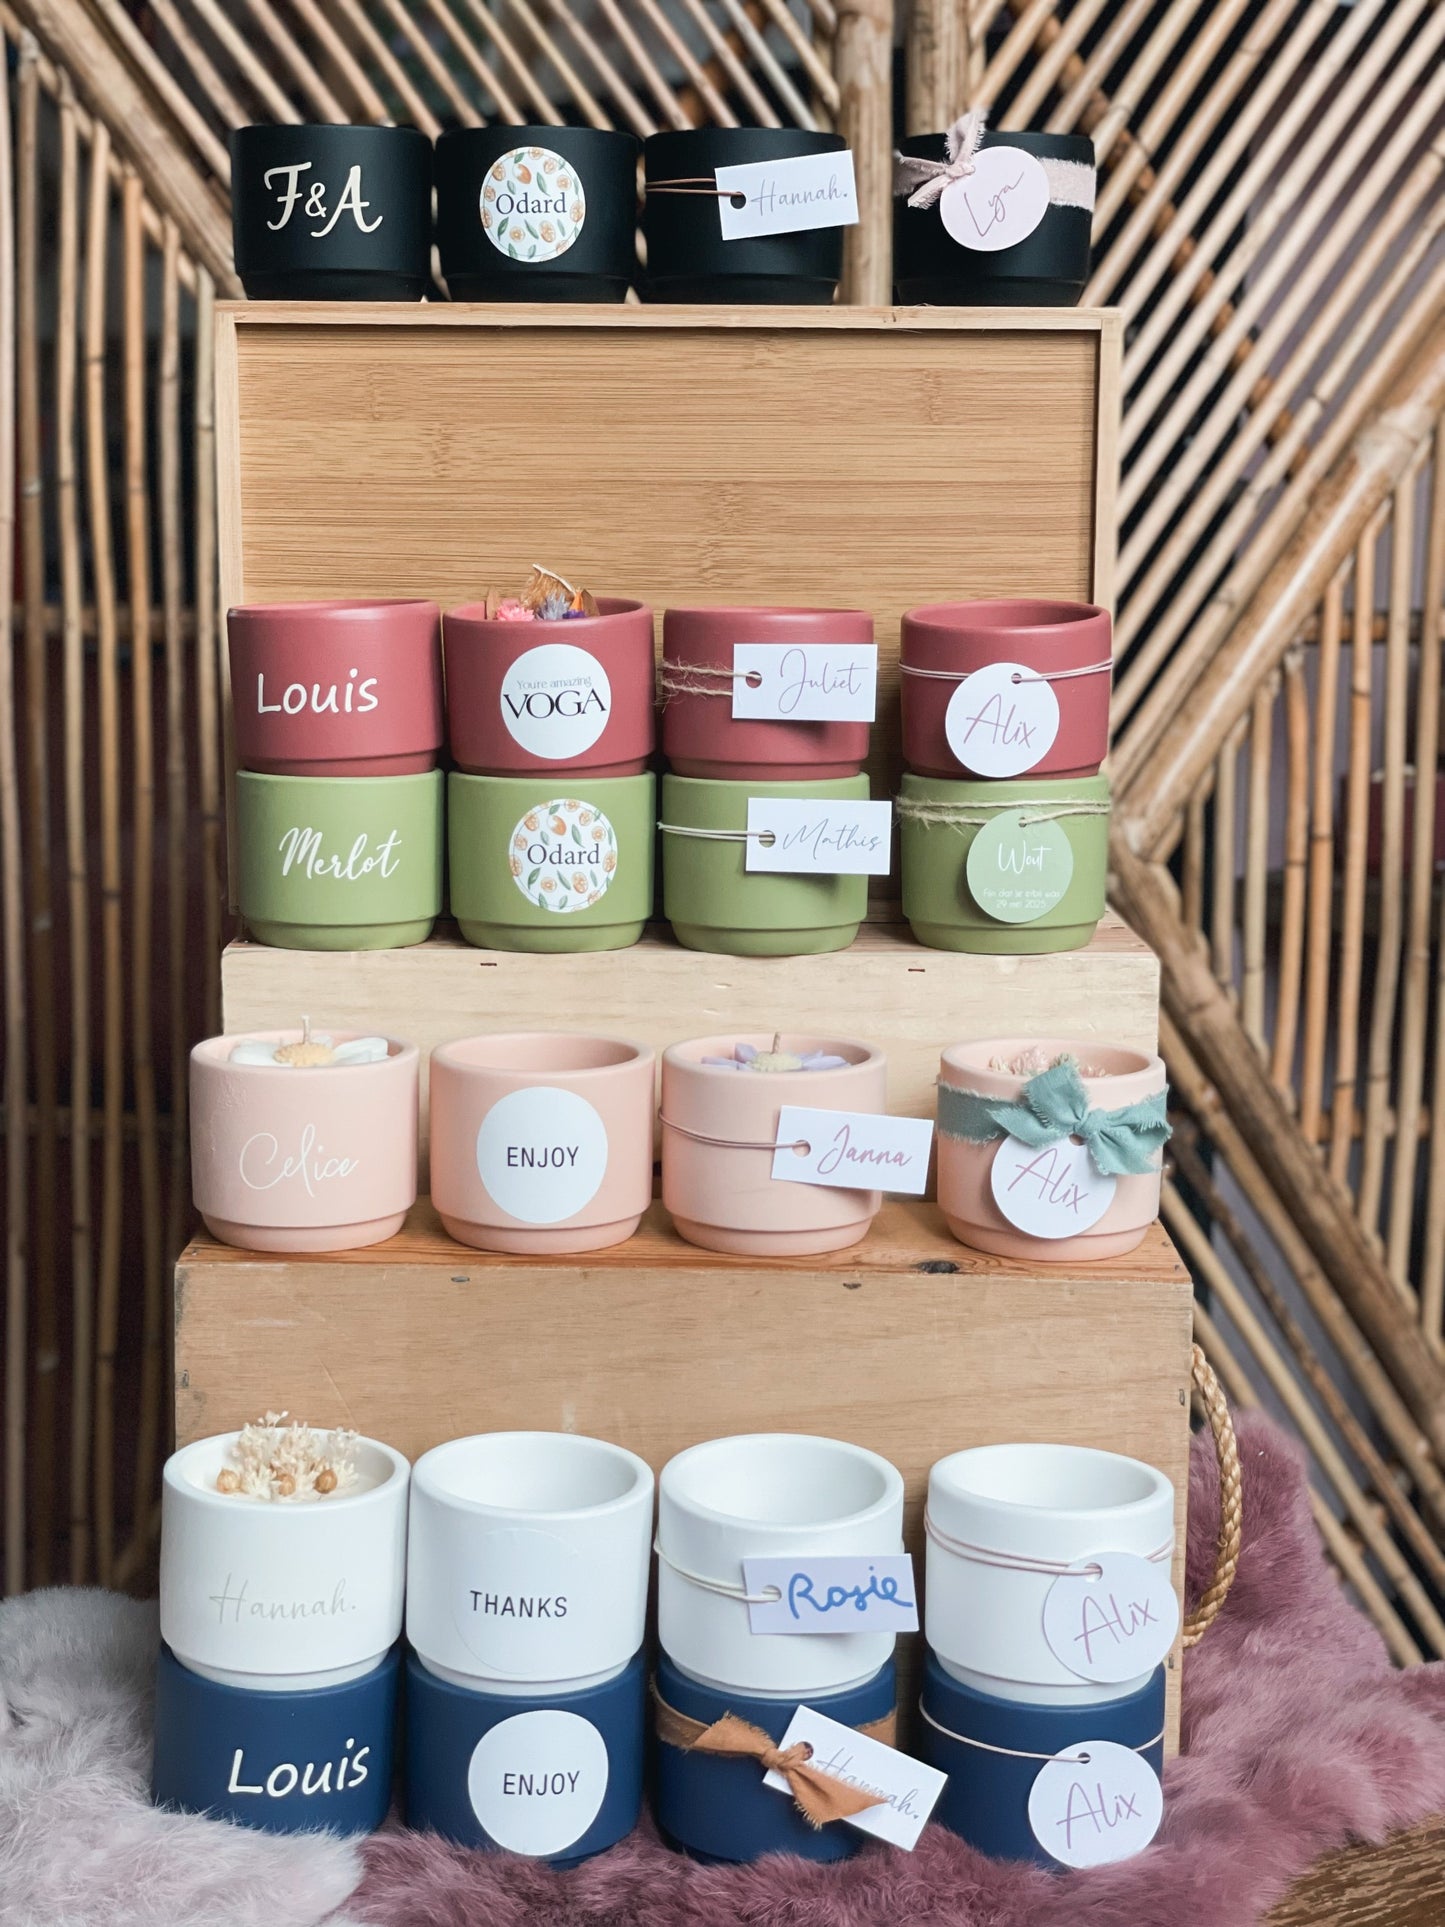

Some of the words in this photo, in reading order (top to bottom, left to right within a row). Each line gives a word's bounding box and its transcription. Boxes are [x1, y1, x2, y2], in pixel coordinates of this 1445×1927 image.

[496, 192, 568, 217] Odard
[750, 173, 848, 218] Hannah.
[257, 667, 379, 715] Louis
[503, 687, 607, 719] VOGA
[549, 676, 593, 689] amazing
[778, 647, 869, 715] Juliet
[962, 692, 1038, 749] Alix
[278, 826, 402, 880] Merlot
[526, 843, 601, 867] Odard
[782, 818, 883, 861] Mathis
[998, 839, 1053, 874] Wout
[239, 1123, 359, 1198] Celice
[507, 1146, 580, 1168] ENJOY
[816, 1123, 913, 1176] Janna
[1007, 1147, 1090, 1215] Alix
[209, 1572, 357, 1625] Hannah.
[470, 1590, 569, 1619] THANKS
[787, 1565, 914, 1620] Rosie
[1073, 1595, 1160, 1665] Alix
[228, 1738, 371, 1798] Louis
[503, 1770, 581, 1797] ENJOY
[1055, 1781, 1143, 1851] Alix
